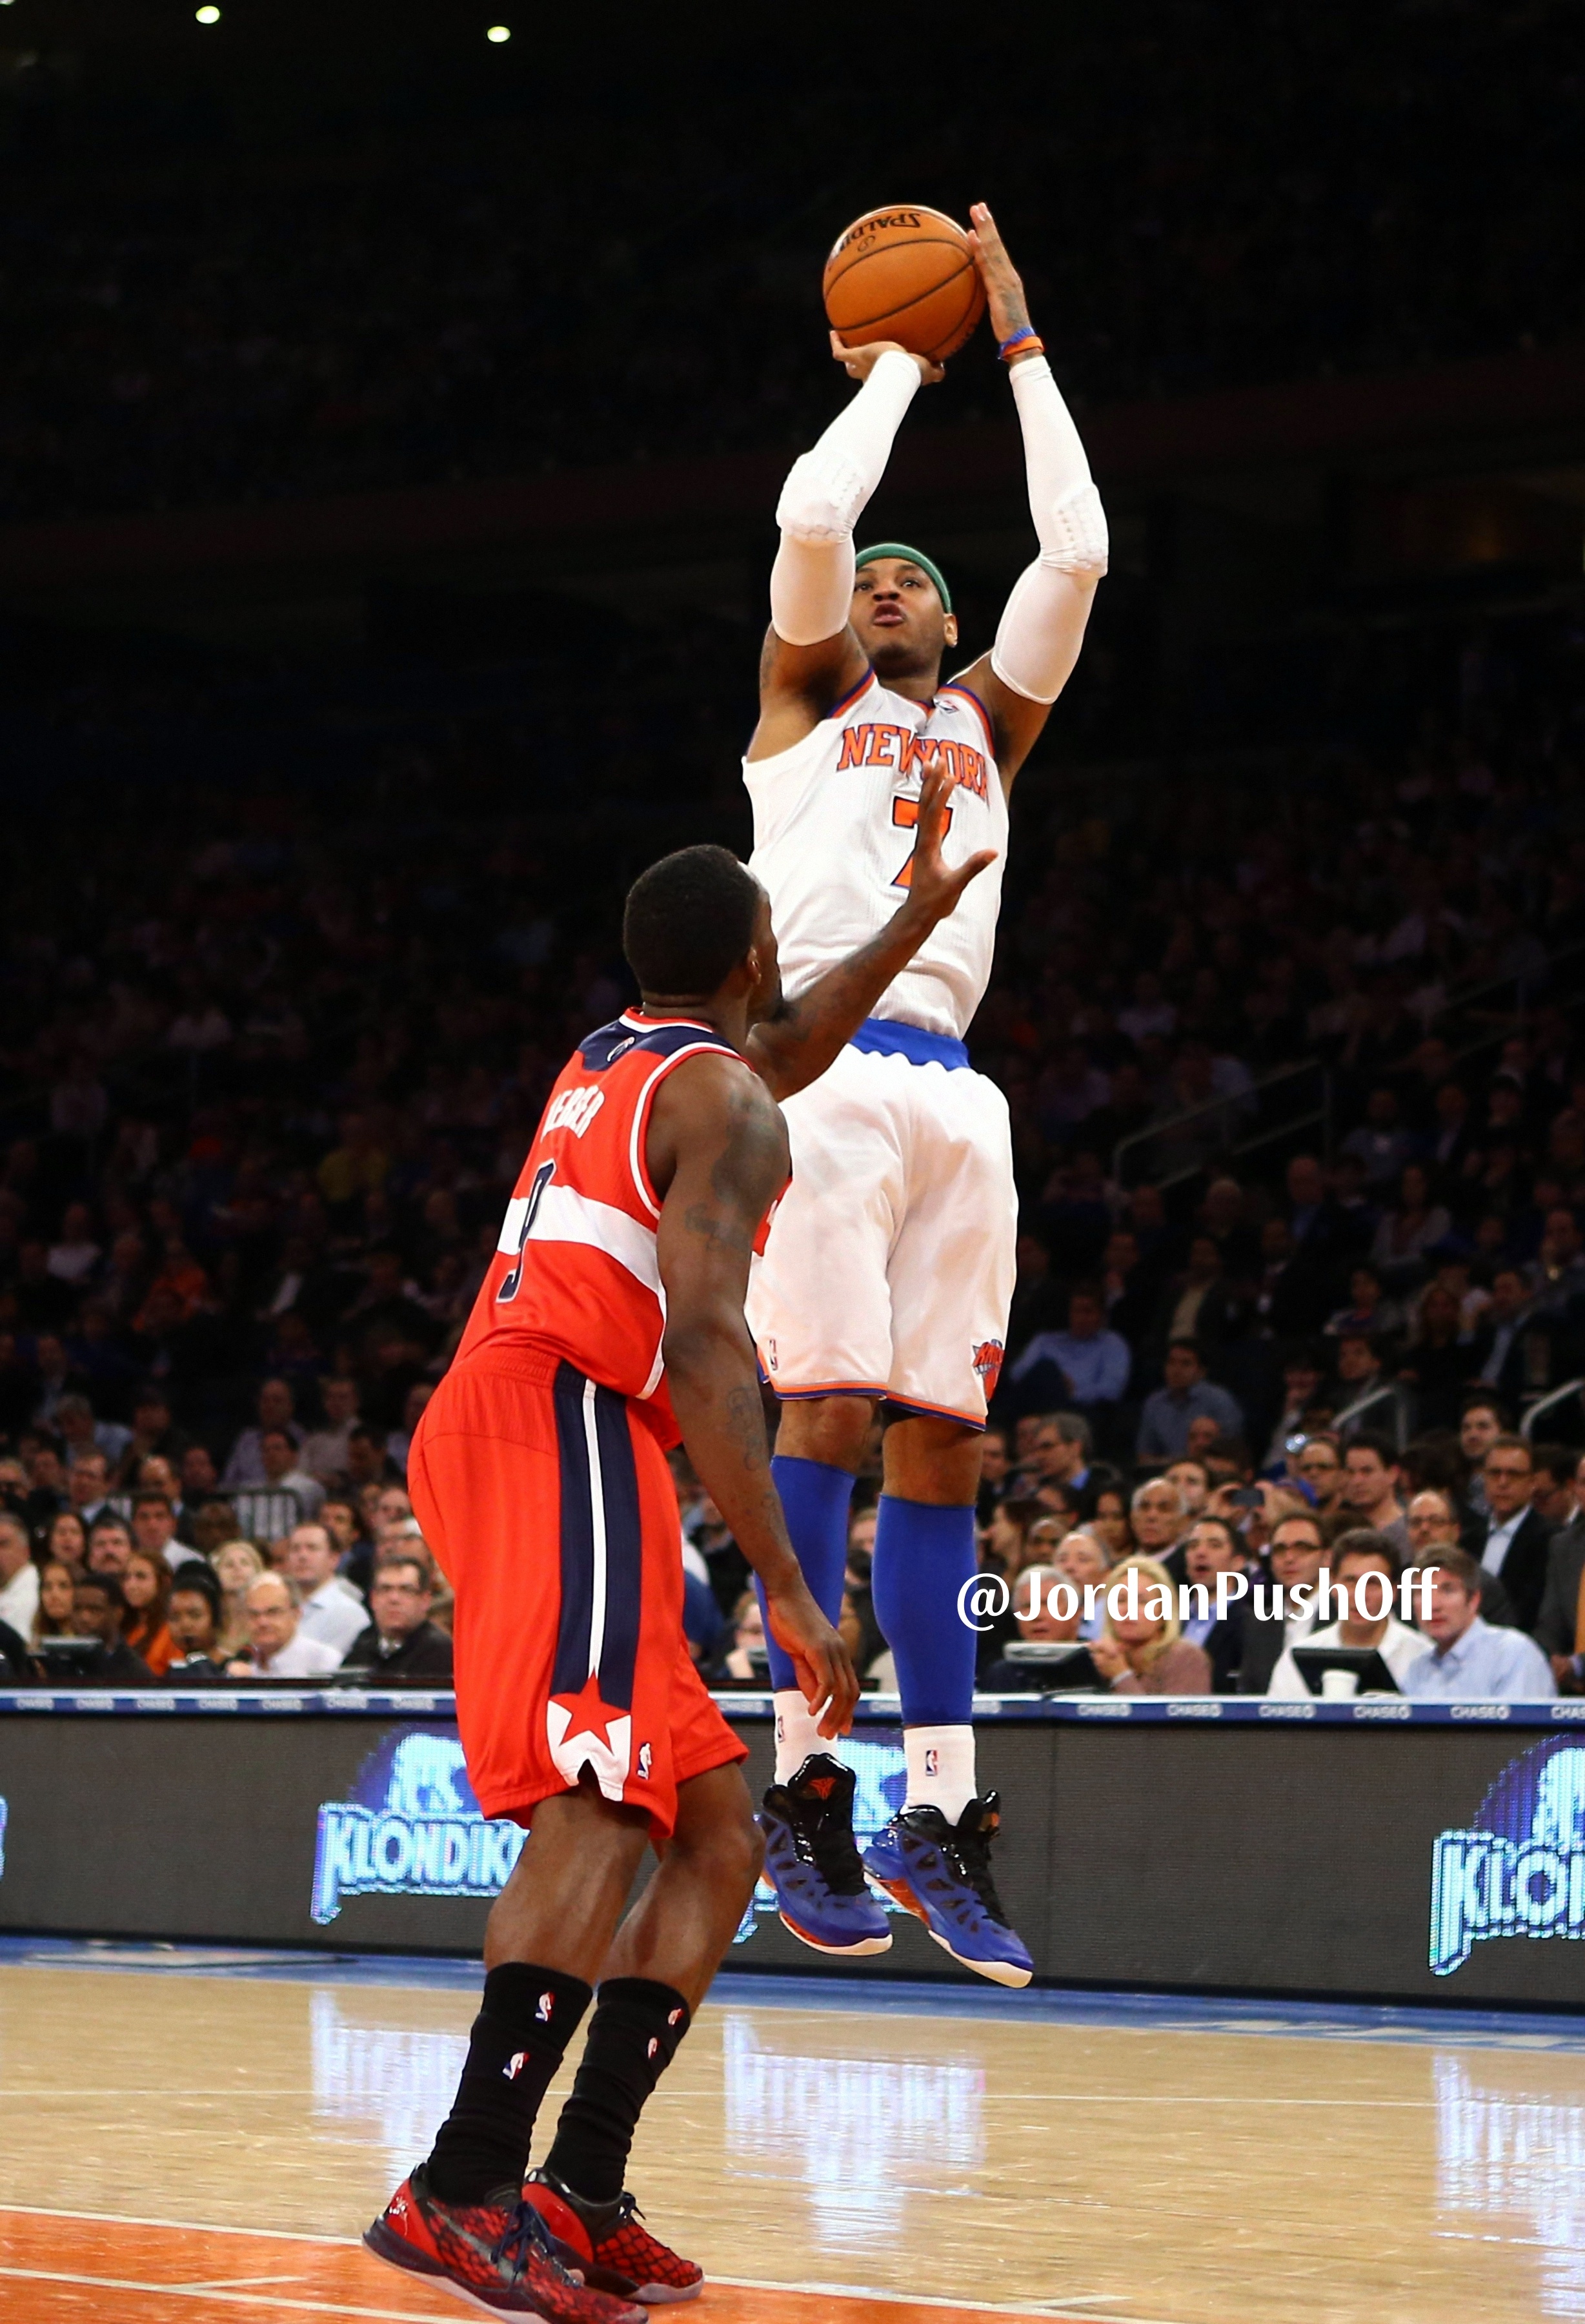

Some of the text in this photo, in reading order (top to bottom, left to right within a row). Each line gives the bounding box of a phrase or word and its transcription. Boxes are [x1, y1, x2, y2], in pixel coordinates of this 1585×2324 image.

[836, 723, 916, 775] NEW
[891, 795, 954, 890] 7
[1451, 1706, 1497, 1719] CHASE
